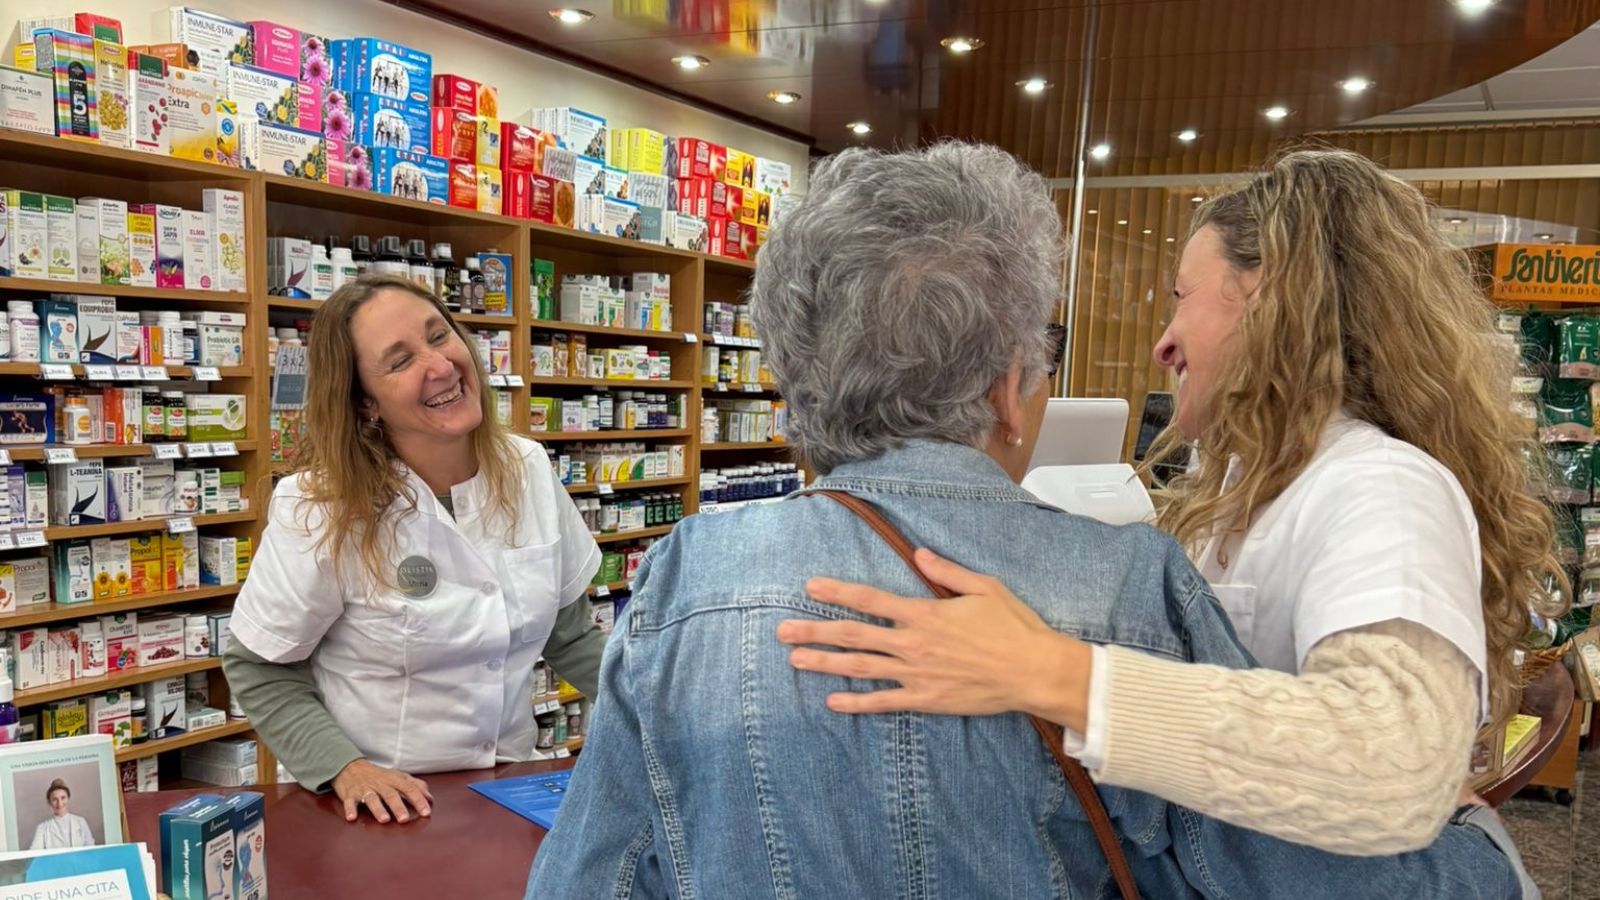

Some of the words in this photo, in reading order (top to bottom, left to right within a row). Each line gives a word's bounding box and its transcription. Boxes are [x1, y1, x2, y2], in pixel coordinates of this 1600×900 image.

[73, 94, 87, 115] 5
[1501, 285, 1552, 295] PLANTAS
[47, 887, 82, 900] UNA
[85, 881, 119, 895] CITA
